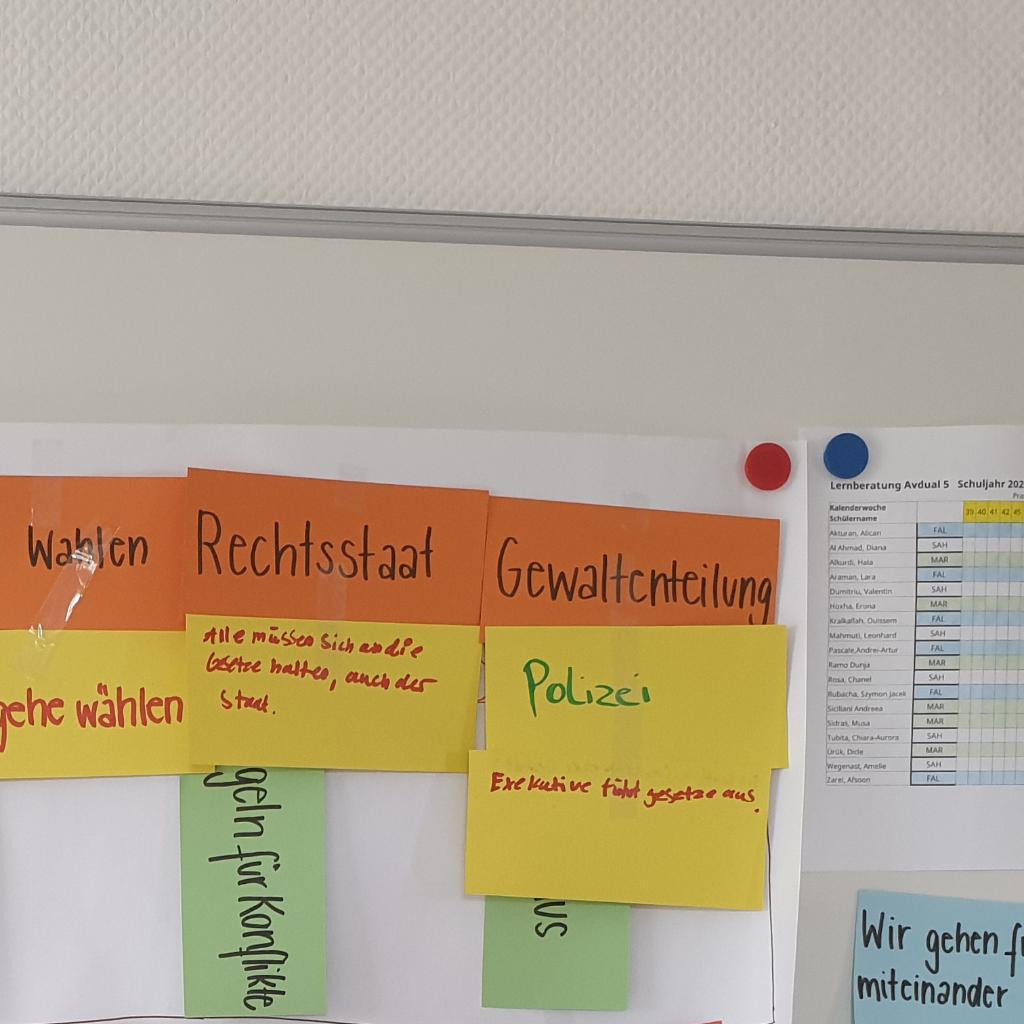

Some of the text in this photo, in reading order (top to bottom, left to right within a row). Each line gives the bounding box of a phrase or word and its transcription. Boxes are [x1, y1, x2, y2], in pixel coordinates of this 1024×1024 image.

[830, 481, 901, 491] Lernberatung
[904, 480, 941, 489] Avdual
[944, 480, 950, 489] 5
[957, 479, 1005, 490] Schuljahr
[829, 504, 886, 512] Kalenderwoche
[829, 514, 877, 522] Schülername
[29, 526, 148, 570] Wahlen
[197, 510, 433, 581] Rechtsstaat
[497, 536, 773, 625] Gewaltenteilung
[203, 626, 246, 645] Alle
[252, 626, 314, 647] müssen
[345, 671, 390, 690] auch
[523, 657, 651, 718] Polizei
[76, 682, 183, 730] wählen
[203, 767, 289, 1011] geln für Konflikte
[862, 909, 911, 950] Wir
[925, 922, 998, 974] gehen
[858, 968, 1008, 1008] miteinander
